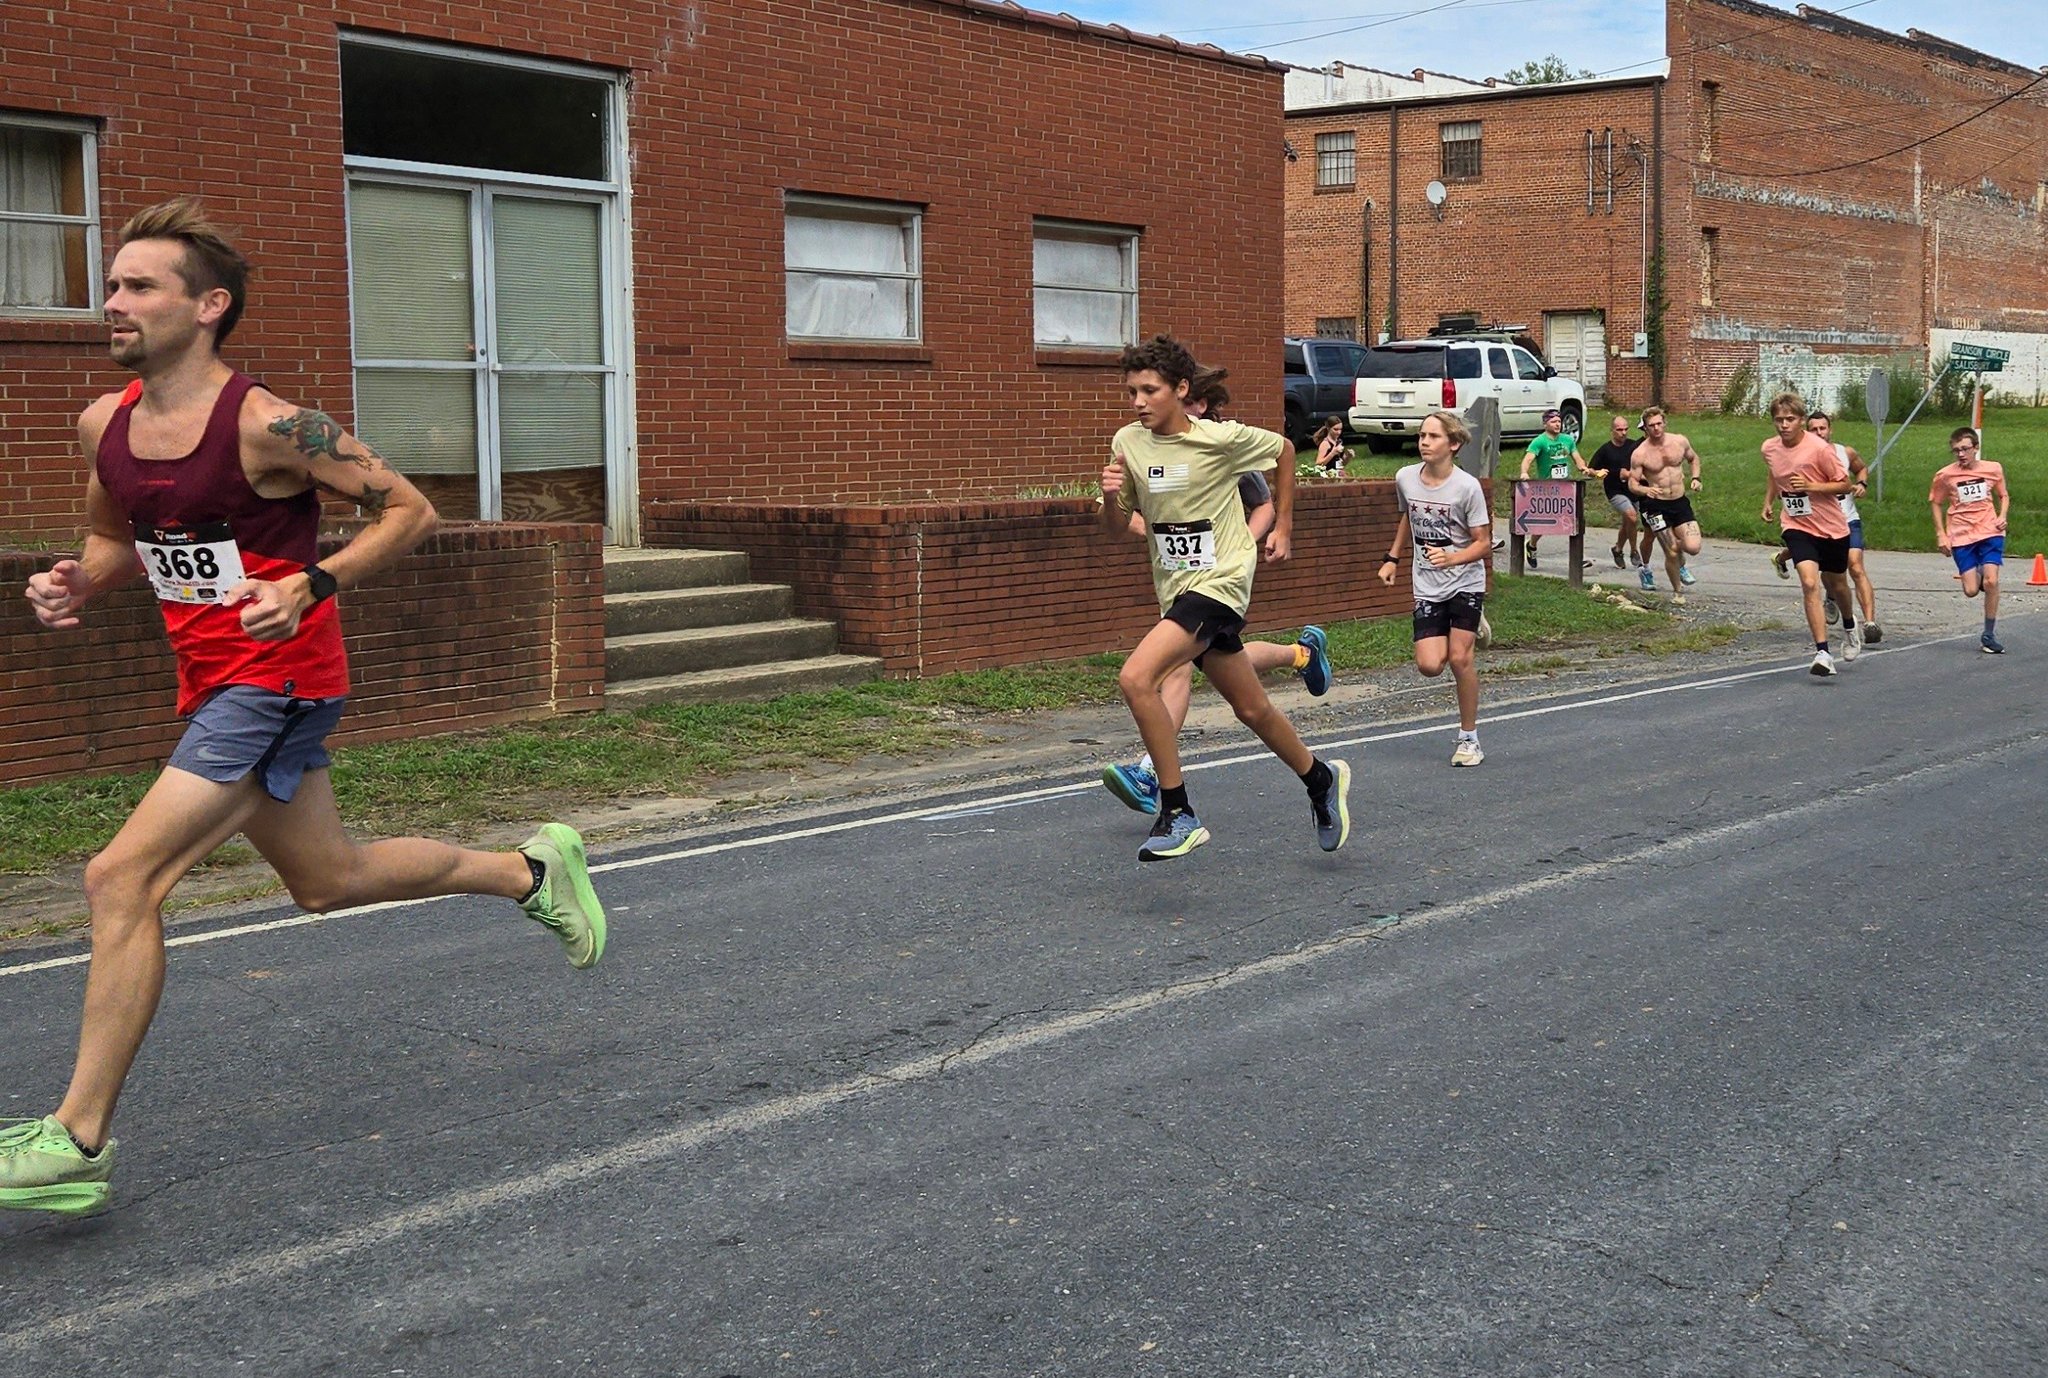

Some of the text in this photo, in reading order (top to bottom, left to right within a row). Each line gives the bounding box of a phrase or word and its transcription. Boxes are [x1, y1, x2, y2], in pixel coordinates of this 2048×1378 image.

[1986, 349, 2009, 361] CIRCLE
[1531, 485, 1560, 495] STELLAR
[1963, 485, 1981, 495] 321
[1530, 497, 1574, 514] SCOOPS
[1165, 535, 1202, 556] 337
[150, 547, 220, 580] 368
